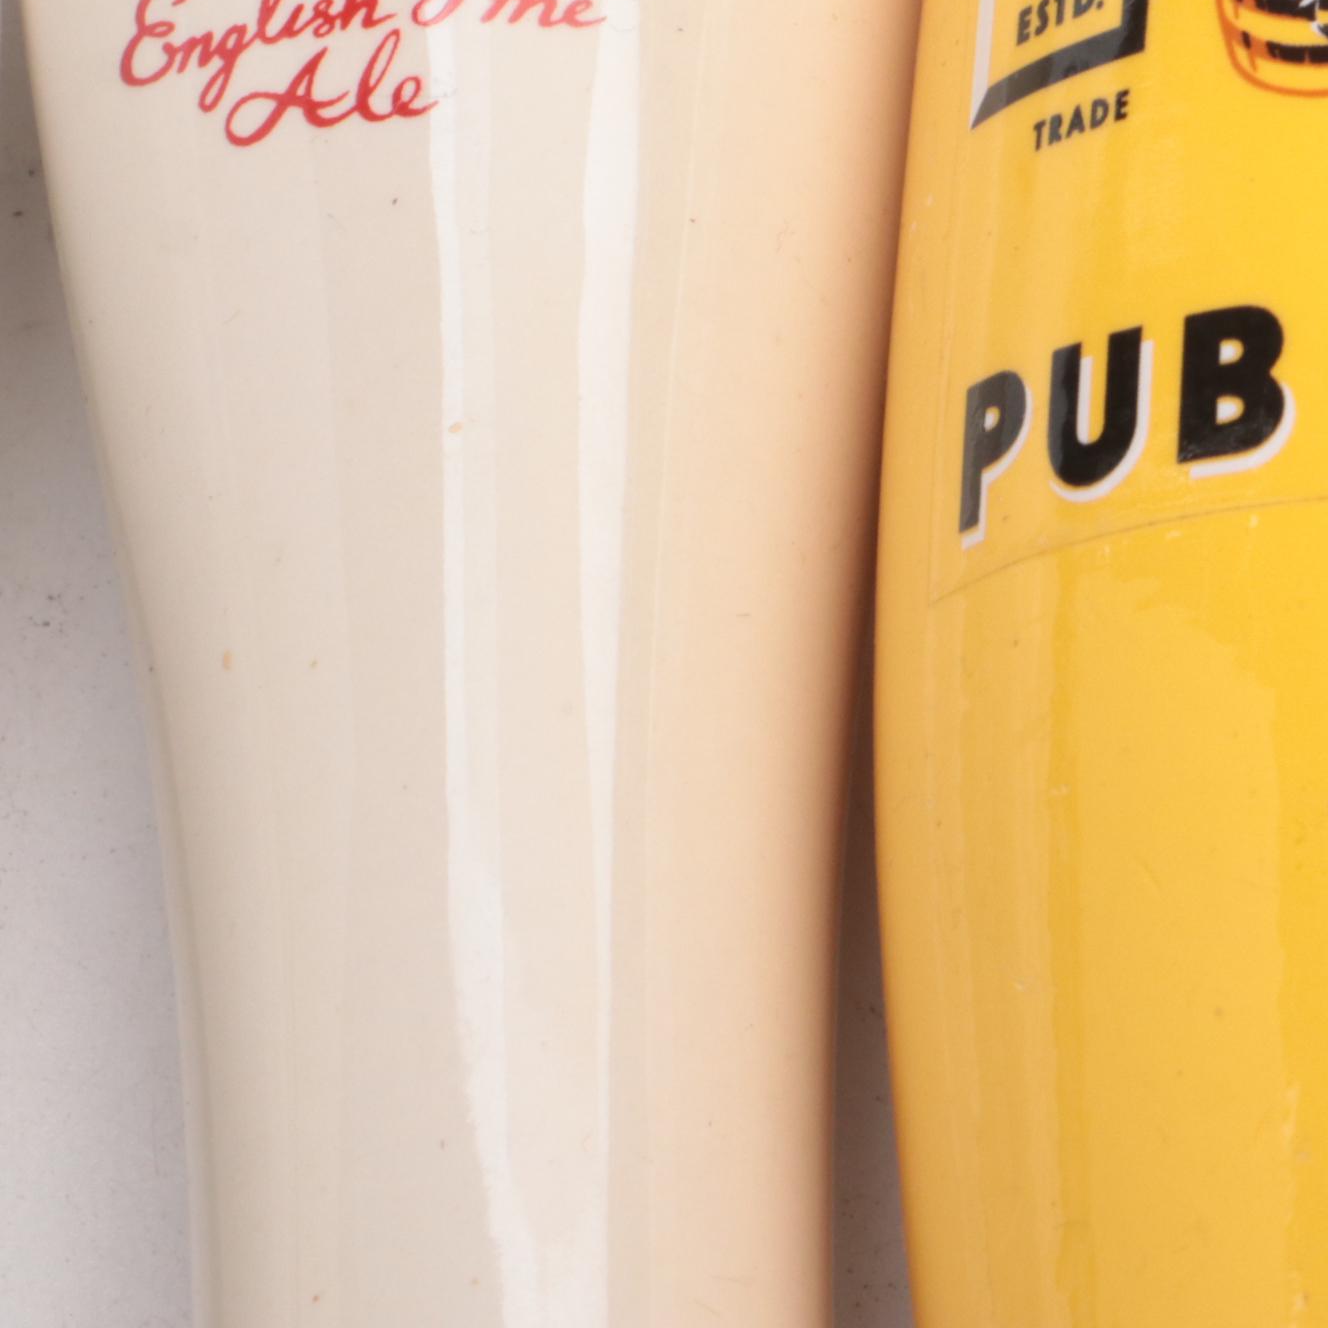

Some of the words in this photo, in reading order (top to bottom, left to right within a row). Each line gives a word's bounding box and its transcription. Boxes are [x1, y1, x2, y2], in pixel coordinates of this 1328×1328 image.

[224, 27, 441, 148] Ale
[1033, 88, 1131, 152] TRADE
[958, 305, 1296, 552] PUB
